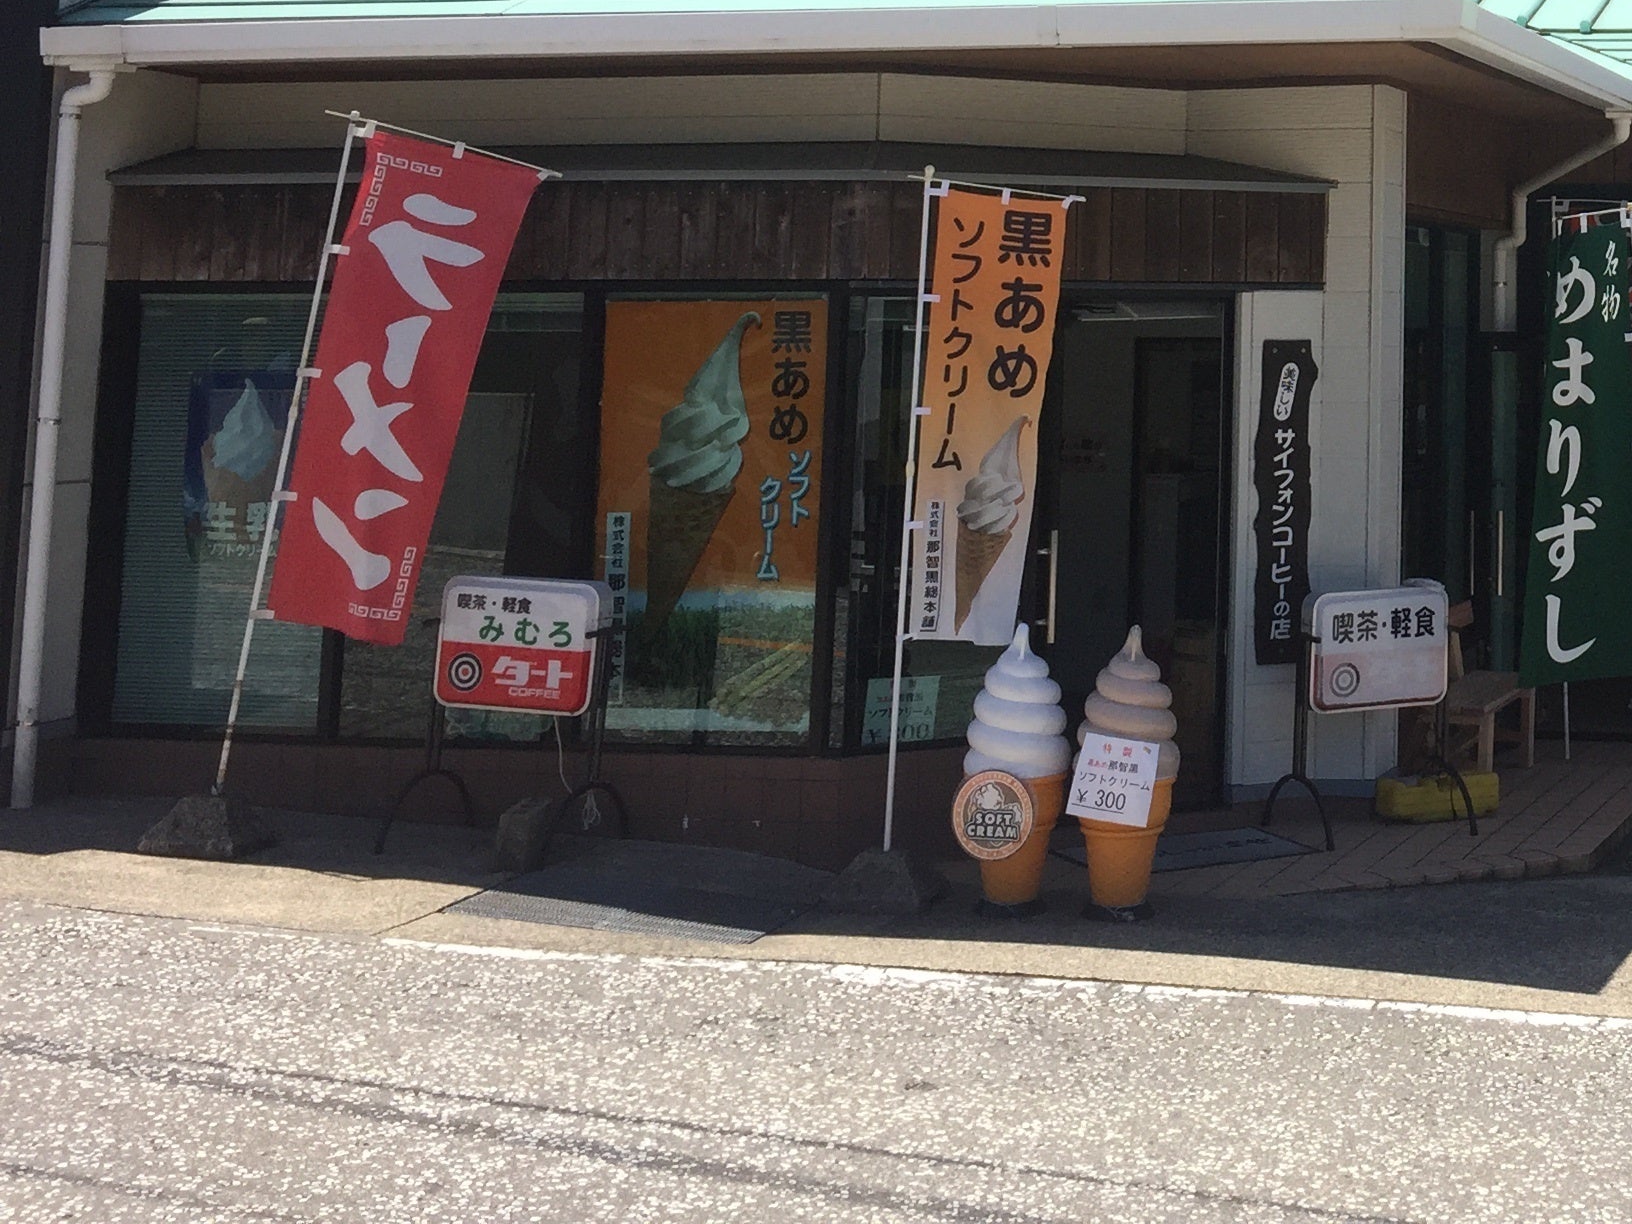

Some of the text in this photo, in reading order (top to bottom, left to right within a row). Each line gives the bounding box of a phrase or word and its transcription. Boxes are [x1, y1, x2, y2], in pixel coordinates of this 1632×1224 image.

[987, 209, 1053, 399] 黒あめ
[1600, 240, 1621, 323] 名物
[931, 216, 986, 472] ソフトクリーム
[769, 310, 812, 445] 黒あめ
[1275, 364, 1297, 417] 美味しい
[787, 449, 811, 527] ソフト
[756, 476, 783, 582] クリーム
[1270, 427, 1296, 641] サイフォンコーヒーの店
[457, 593, 532, 615] 喫茶・軽食
[1332, 605, 1436, 644] 喫茶・軽食
[478, 615, 573, 648] みむろ
[508, 686, 562, 700] COFFEE
[1078, 770, 1151, 792] ソフトクリーム
[1094, 789, 1127, 811] 300
[966, 824, 1018, 838] CREAM
[975, 812, 1013, 826] SOFT
